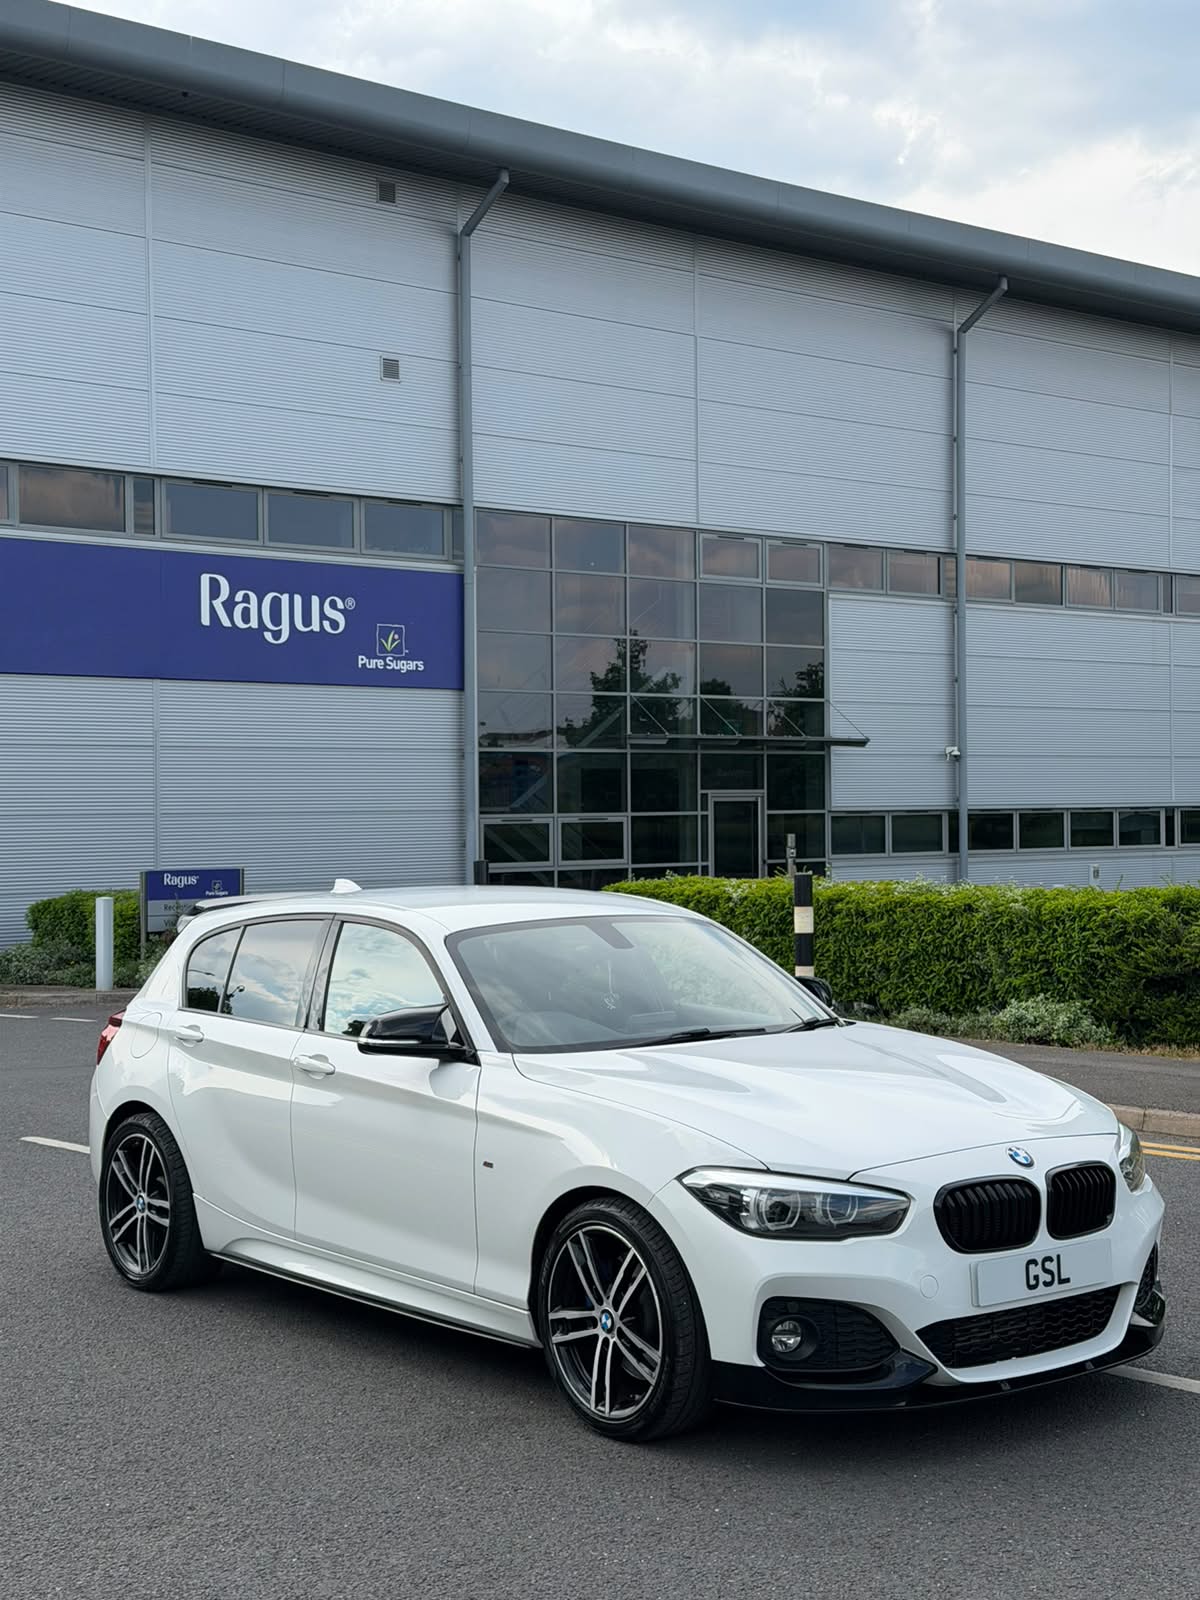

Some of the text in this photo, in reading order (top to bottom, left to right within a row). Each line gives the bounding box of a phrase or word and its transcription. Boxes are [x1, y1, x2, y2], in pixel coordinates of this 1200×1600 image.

[358, 655, 424, 673] Pure Sugars
[1025, 1254, 1070, 1290] GSL
